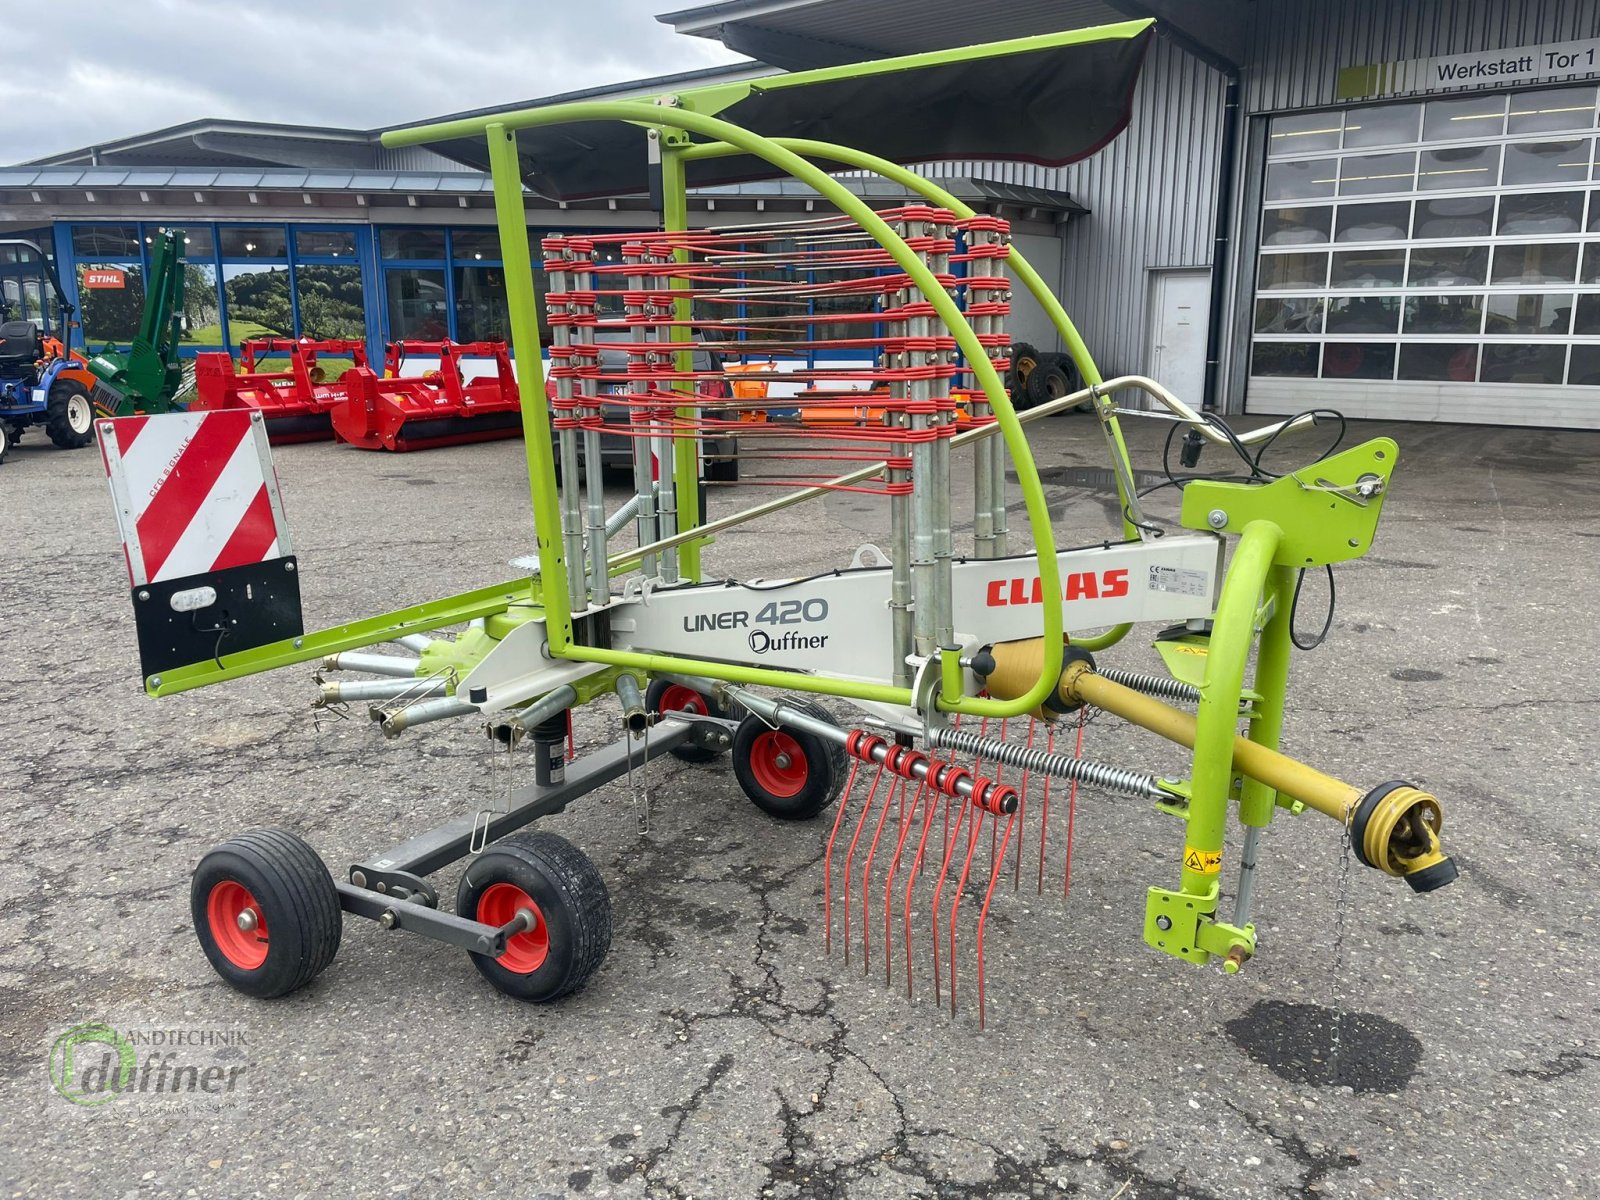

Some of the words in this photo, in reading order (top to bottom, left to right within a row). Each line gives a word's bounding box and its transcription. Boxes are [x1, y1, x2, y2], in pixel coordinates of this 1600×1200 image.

[1437, 56, 1533, 81] Werkstatt
[1545, 52, 1580, 70] Tor
[1585, 48, 1595, 65] 1
[88, 275, 120, 284] STIHL
[149, 477, 166, 497] CFG
[683, 610, 749, 633] LINER
[755, 598, 829, 626] 420
[748, 629, 829, 655] Duffner
